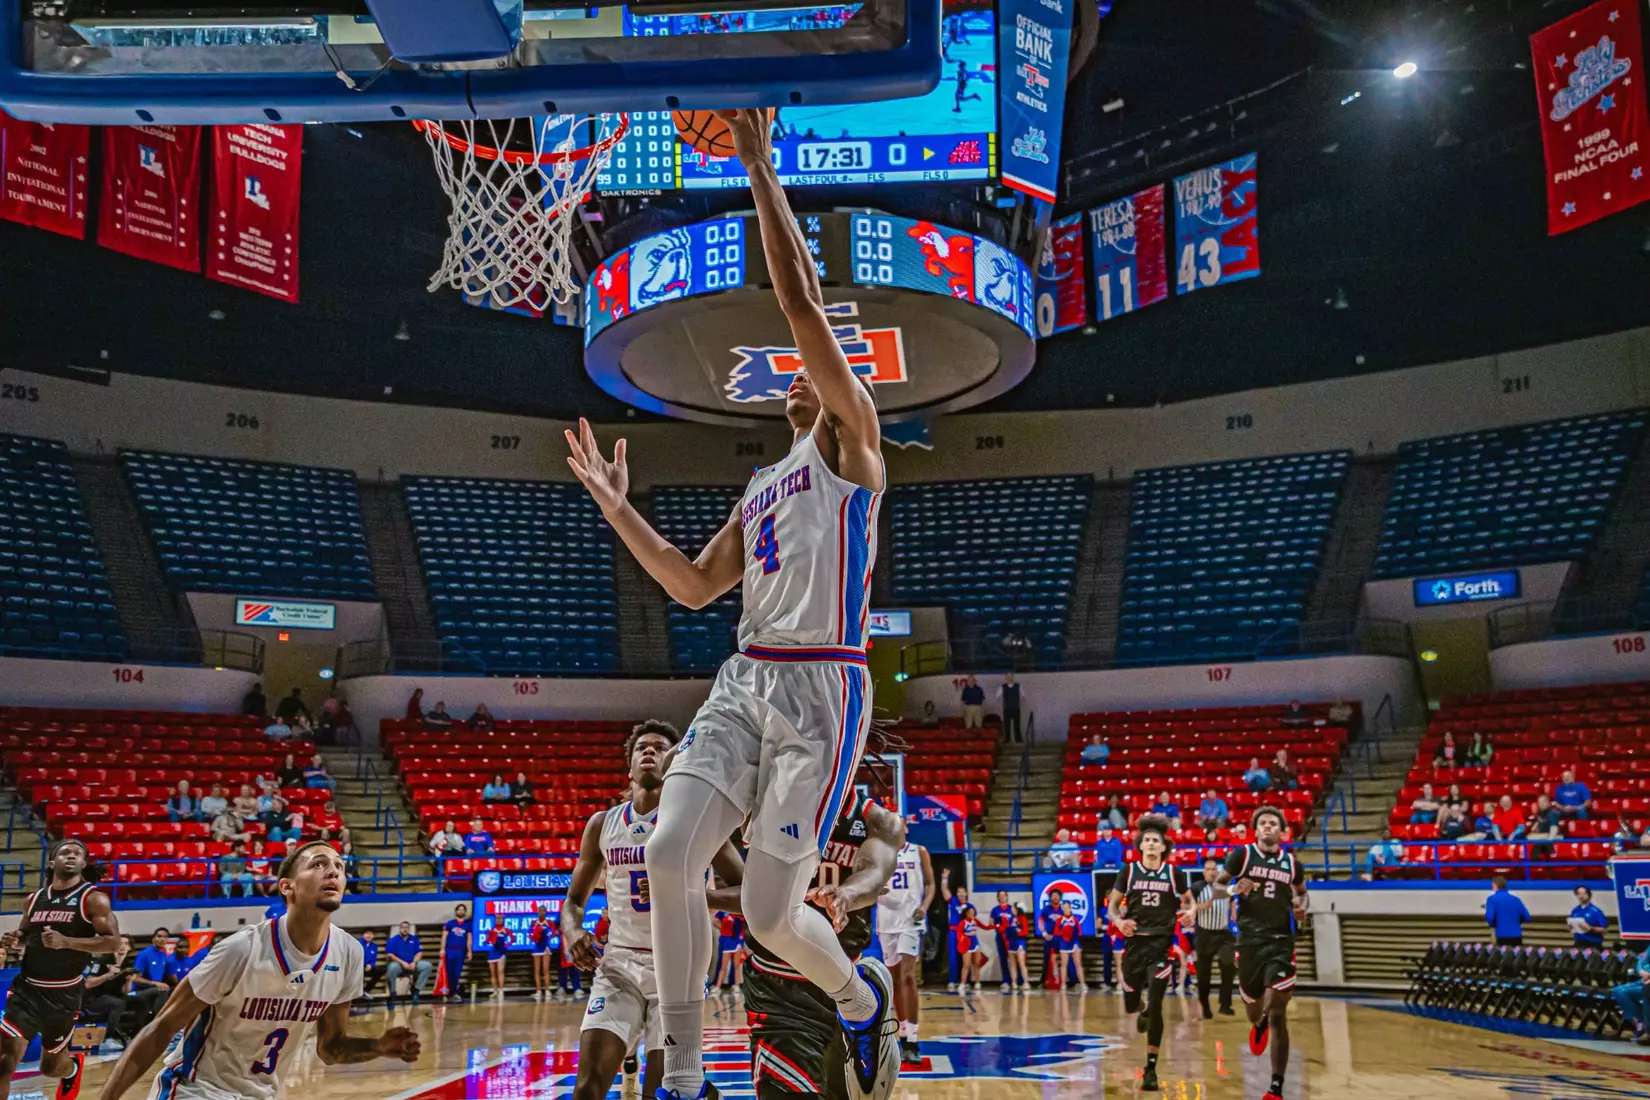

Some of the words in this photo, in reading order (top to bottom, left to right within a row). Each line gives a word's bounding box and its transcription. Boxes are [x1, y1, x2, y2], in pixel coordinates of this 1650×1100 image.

[1016, 13, 1053, 42] OFFICIAL
[1016, 28, 1053, 63] BANK
[243, 127, 272, 144] TECH
[633, 125, 643, 137] 0
[648, 125, 658, 136] 0
[662, 125, 671, 136] 0
[227, 132, 288, 160] UNIVERSITY
[617, 141, 627, 153] 0
[635, 141, 642, 153] 1
[649, 141, 658, 152] 0
[662, 140, 672, 152] 0
[802, 146, 864, 169] 17:31
[888, 143, 907, 165] 0
[1575, 139, 1619, 164] NCAA
[17, 156, 60, 177] NATIONAL
[229, 144, 286, 171] BULLDOGS
[617, 158, 627, 169] 0
[636, 157, 642, 169] 1
[649, 157, 659, 168] 0
[663, 156, 672, 168] 0
[1554, 163, 1599, 184] FINAL
[1599, 141, 1639, 168] FOUR
[7, 172, 67, 196] INVITATIONAL
[618, 173, 627, 184] 0
[636, 172, 642, 184] 1
[649, 172, 659, 183] 0
[663, 172, 672, 183] 0
[867, 173, 885, 182] FLS
[923, 171, 941, 181] FLS
[1175, 167, 1221, 203] VENUS
[7, 190, 67, 213] TOURNAMENT
[1090, 197, 1135, 233] TERESA
[705, 222, 740, 245] 0.0
[856, 218, 892, 239] 0.0
[705, 244, 740, 267] 0.0
[857, 240, 893, 262] 0.0
[857, 262, 893, 284] 0.0
[1177, 237, 1221, 291] 43
[705, 266, 740, 289] 0.0
[1099, 266, 1133, 320] 11
[2, 383, 39, 402] 205
[1503, 375, 1530, 394] 211
[225, 412, 260, 430] 206
[1226, 414, 1253, 430] 210
[491, 435, 521, 450] 207
[780, 464, 811, 500] TECH
[753, 512, 781, 576] 4
[1455, 578, 1499, 596] Forth
[1612, 636, 1646, 654] 108
[112, 667, 145, 684] 104
[1207, 667, 1232, 682] 107
[513, 681, 540, 695] 105
[892, 872, 910, 889] 21
[1133, 880, 1149, 890] JAX
[1249, 866, 1269, 878] JAX
[1268, 869, 1291, 884] STATE
[628, 870, 651, 912] 5
[1141, 891, 1161, 907] 23
[1263, 880, 1276, 899] 2
[30, 911, 48, 922] JAX
[47, 910, 76, 922] STATE
[493, 901, 533, 913] THANK
[250, 1027, 290, 1076] 3
